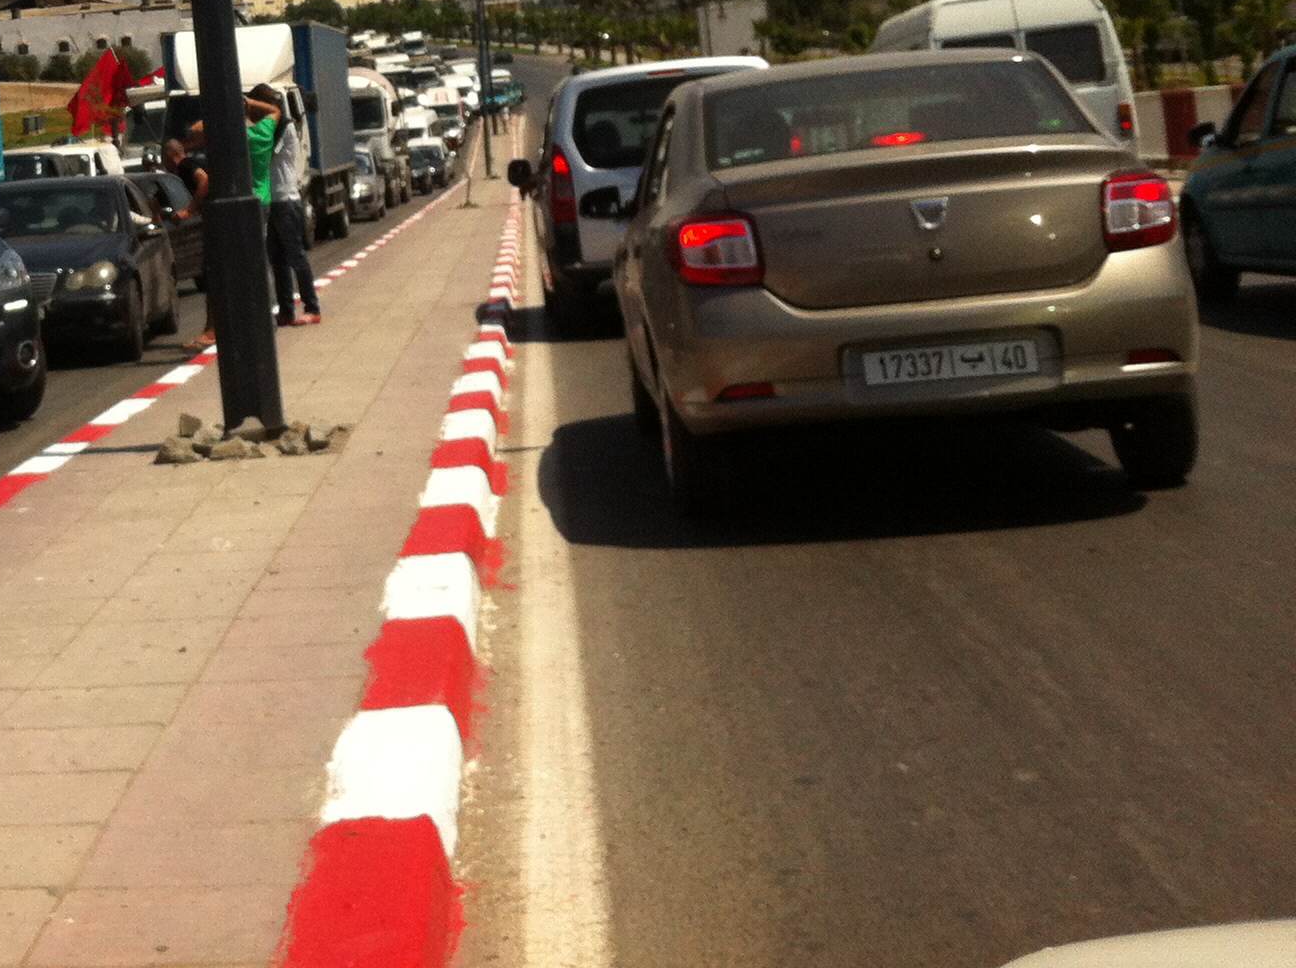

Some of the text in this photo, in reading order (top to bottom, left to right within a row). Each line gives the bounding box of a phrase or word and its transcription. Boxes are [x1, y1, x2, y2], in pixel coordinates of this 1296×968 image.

[878, 344, 1028, 380] 17337 ب 40
